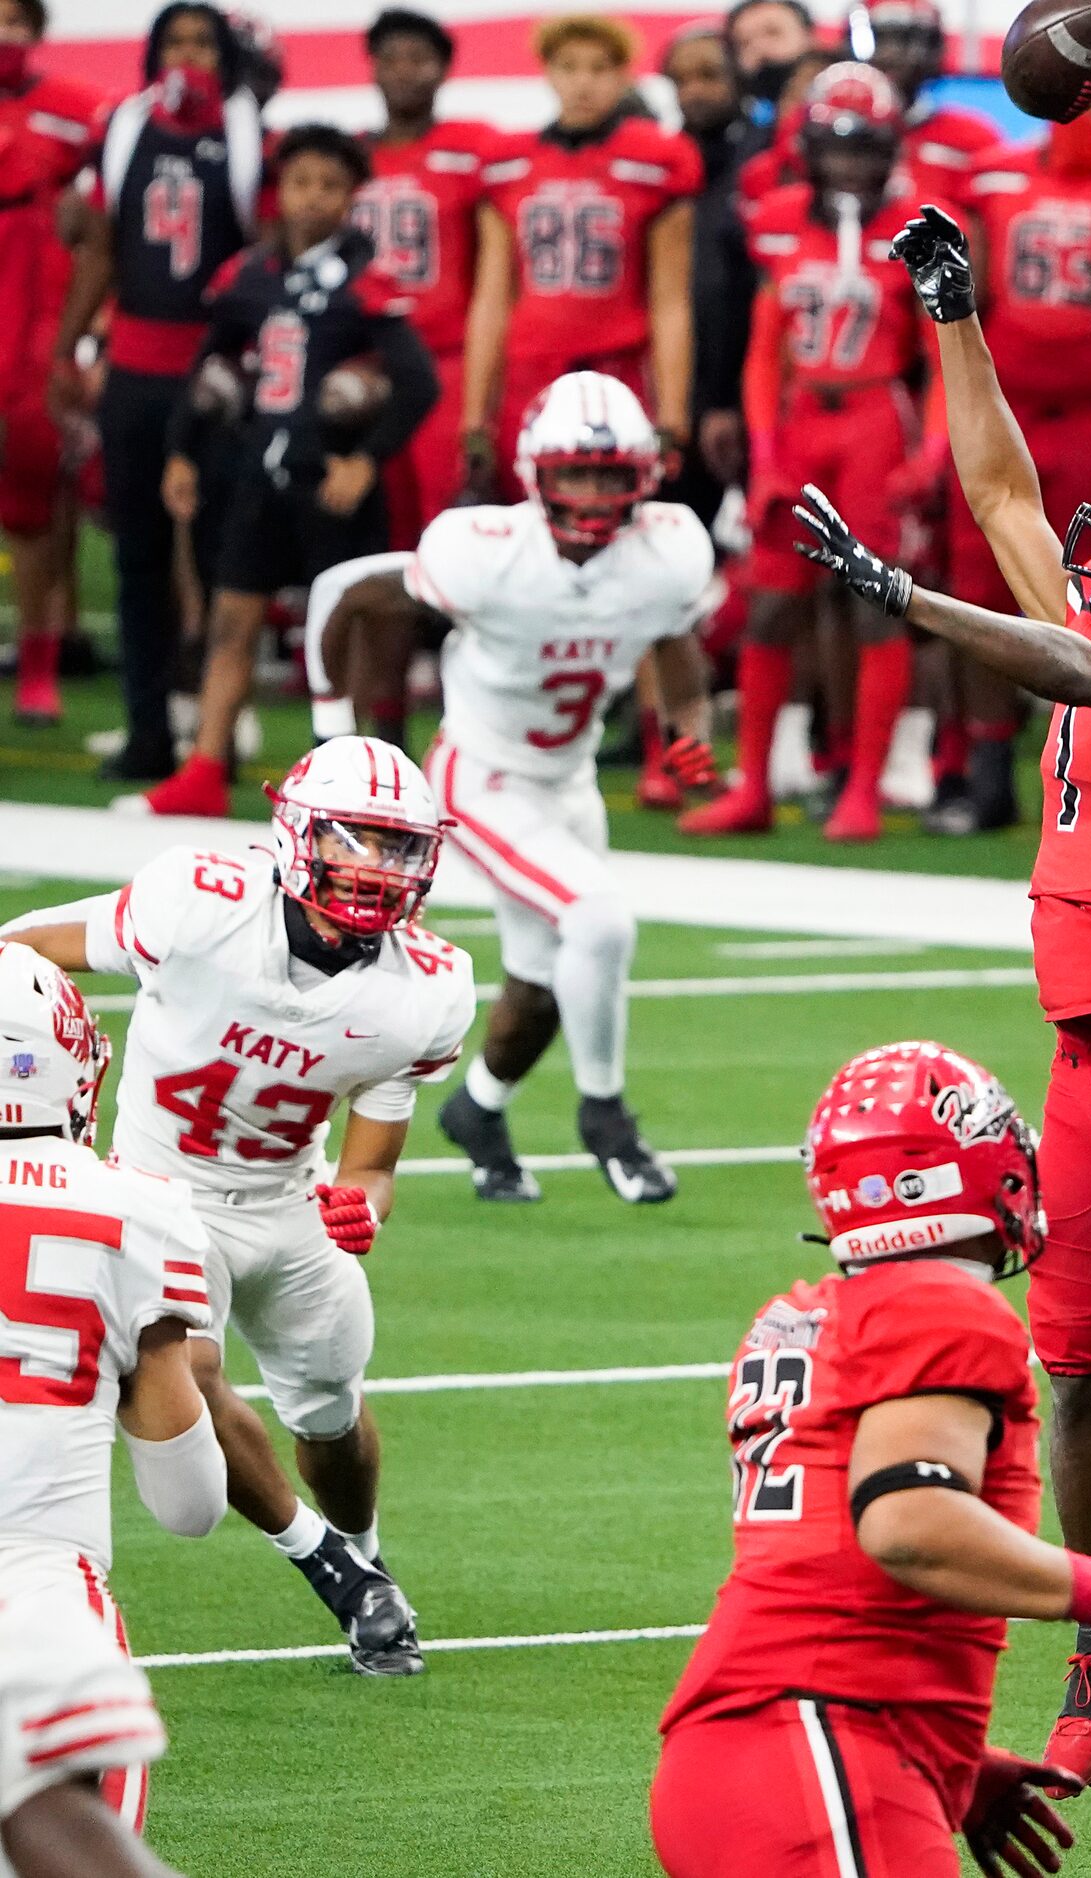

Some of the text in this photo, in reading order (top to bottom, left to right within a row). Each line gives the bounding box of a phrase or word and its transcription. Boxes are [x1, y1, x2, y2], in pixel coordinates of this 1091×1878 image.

[518, 196, 624, 296] 86
[255, 310, 309, 412] 5
[525, 669, 606, 750] 3
[1055, 705, 1081, 832] 1
[219, 1021, 326, 1077] KATY
[0, 1103, 22, 1123] ll
[152, 1055, 335, 1162] 43
[0, 1159, 68, 1190] ING
[846, 1222, 945, 1258] Riddell
